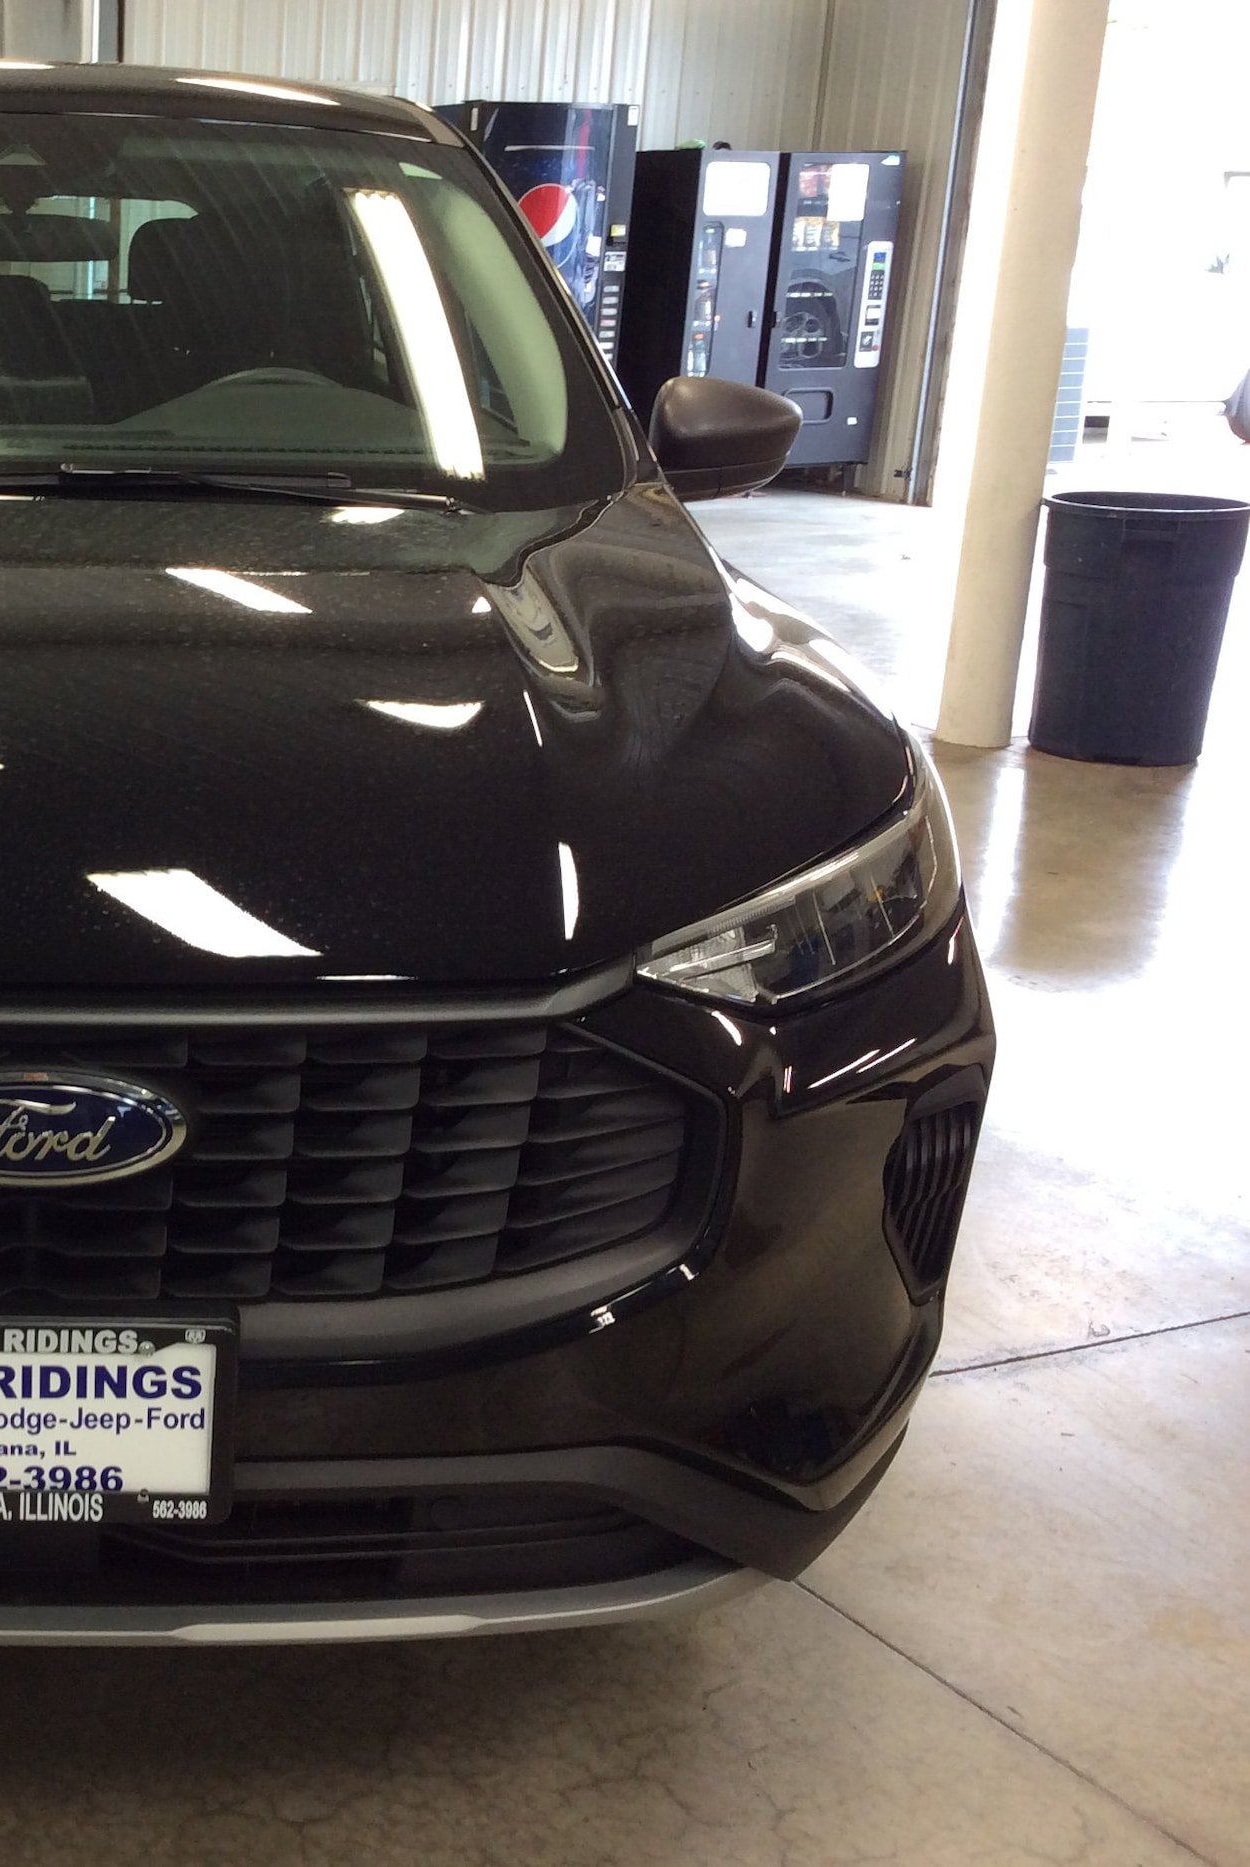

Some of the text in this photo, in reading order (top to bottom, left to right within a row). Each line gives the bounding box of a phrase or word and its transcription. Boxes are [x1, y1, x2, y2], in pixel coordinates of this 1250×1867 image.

[4, 1328, 138, 1354] RIDINGS
[54, 1441, 77, 1456] IL
[19, 1491, 104, 1523] ILLINOIS
[152, 1499, 208, 1520] 562-3986
